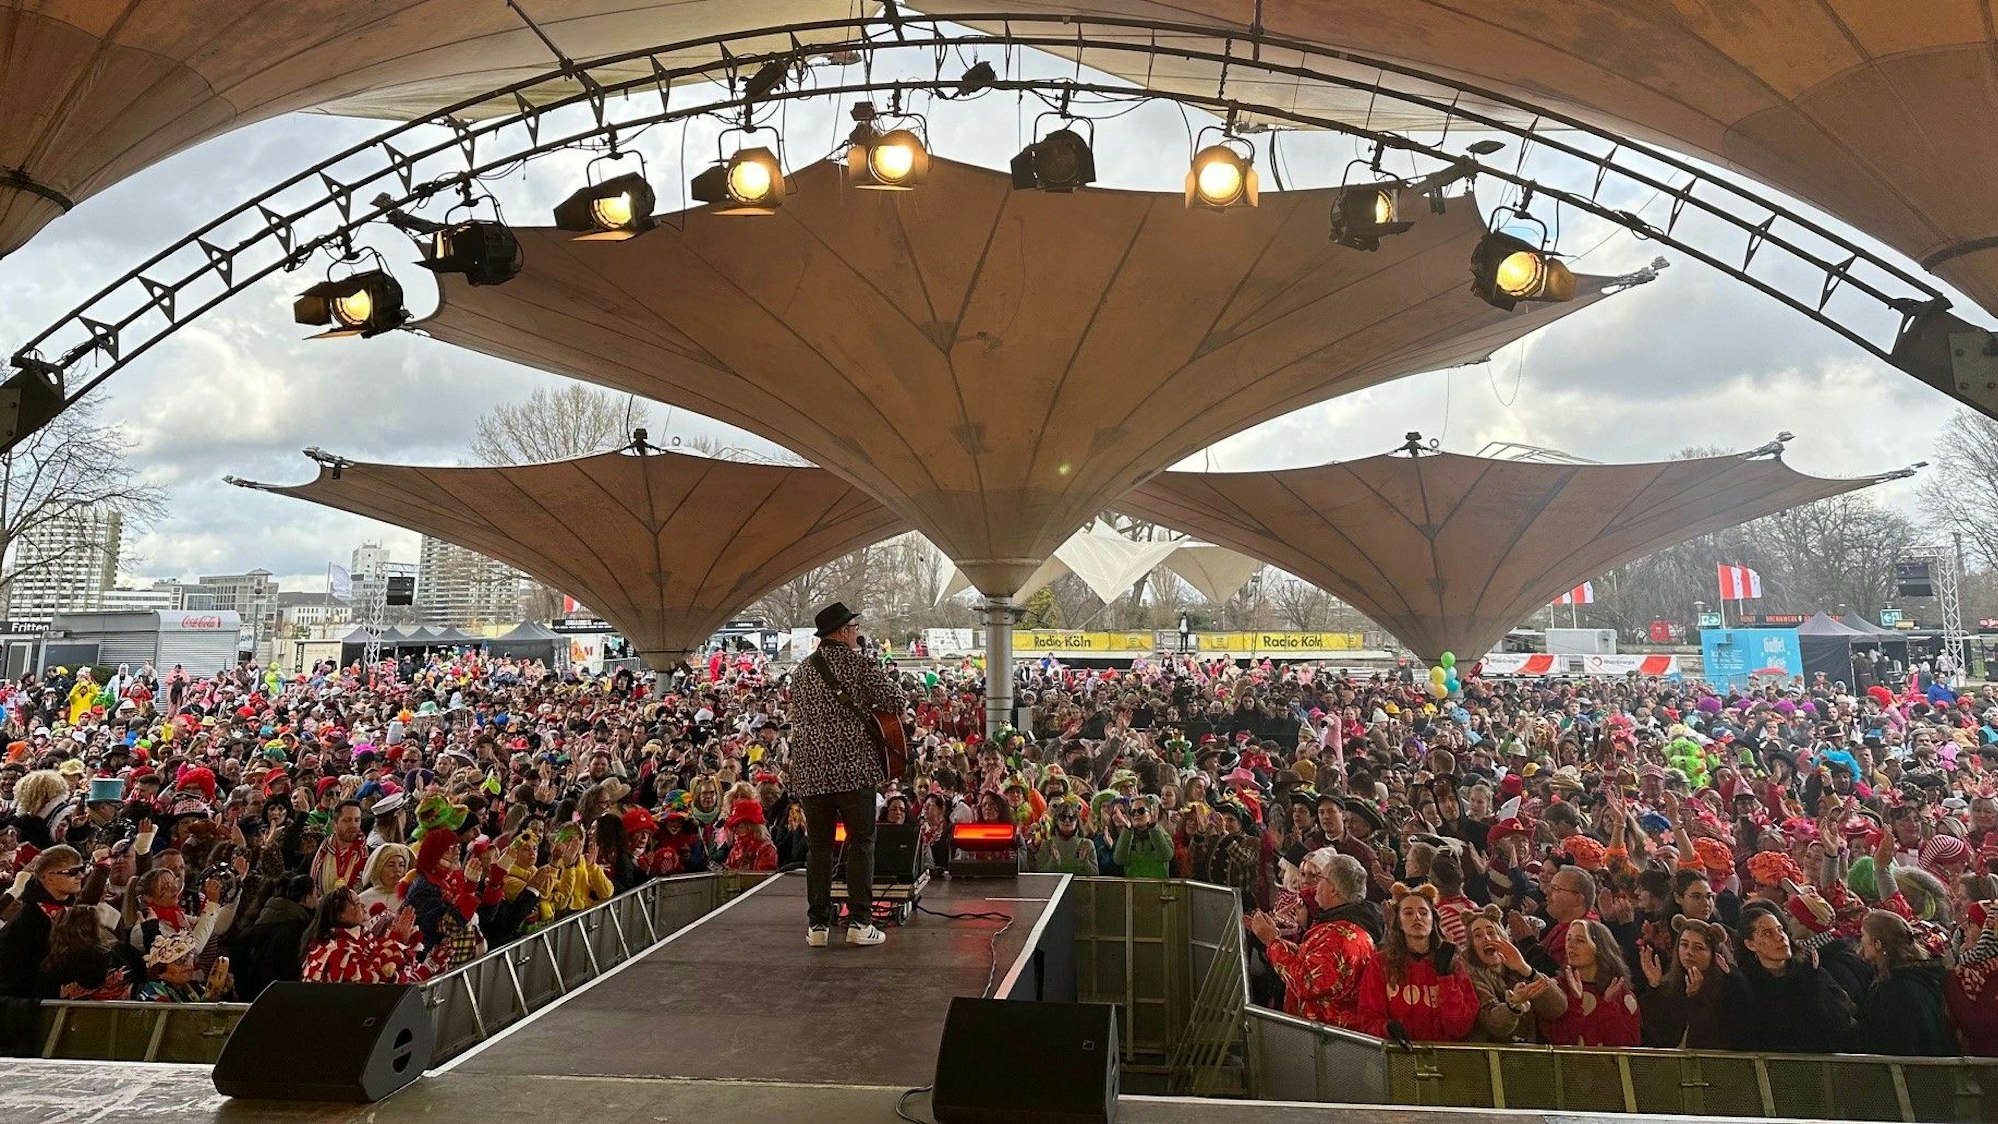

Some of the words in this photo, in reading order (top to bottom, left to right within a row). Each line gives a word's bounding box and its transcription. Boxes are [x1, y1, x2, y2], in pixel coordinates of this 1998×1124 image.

[11, 623, 49, 633] Fritten
[182, 615, 216, 628] Coca-Cola
[1034, 635, 1062, 648] Radio
[1065, 634, 1091, 648] Köln
[1263, 635, 1298, 648] Radio
